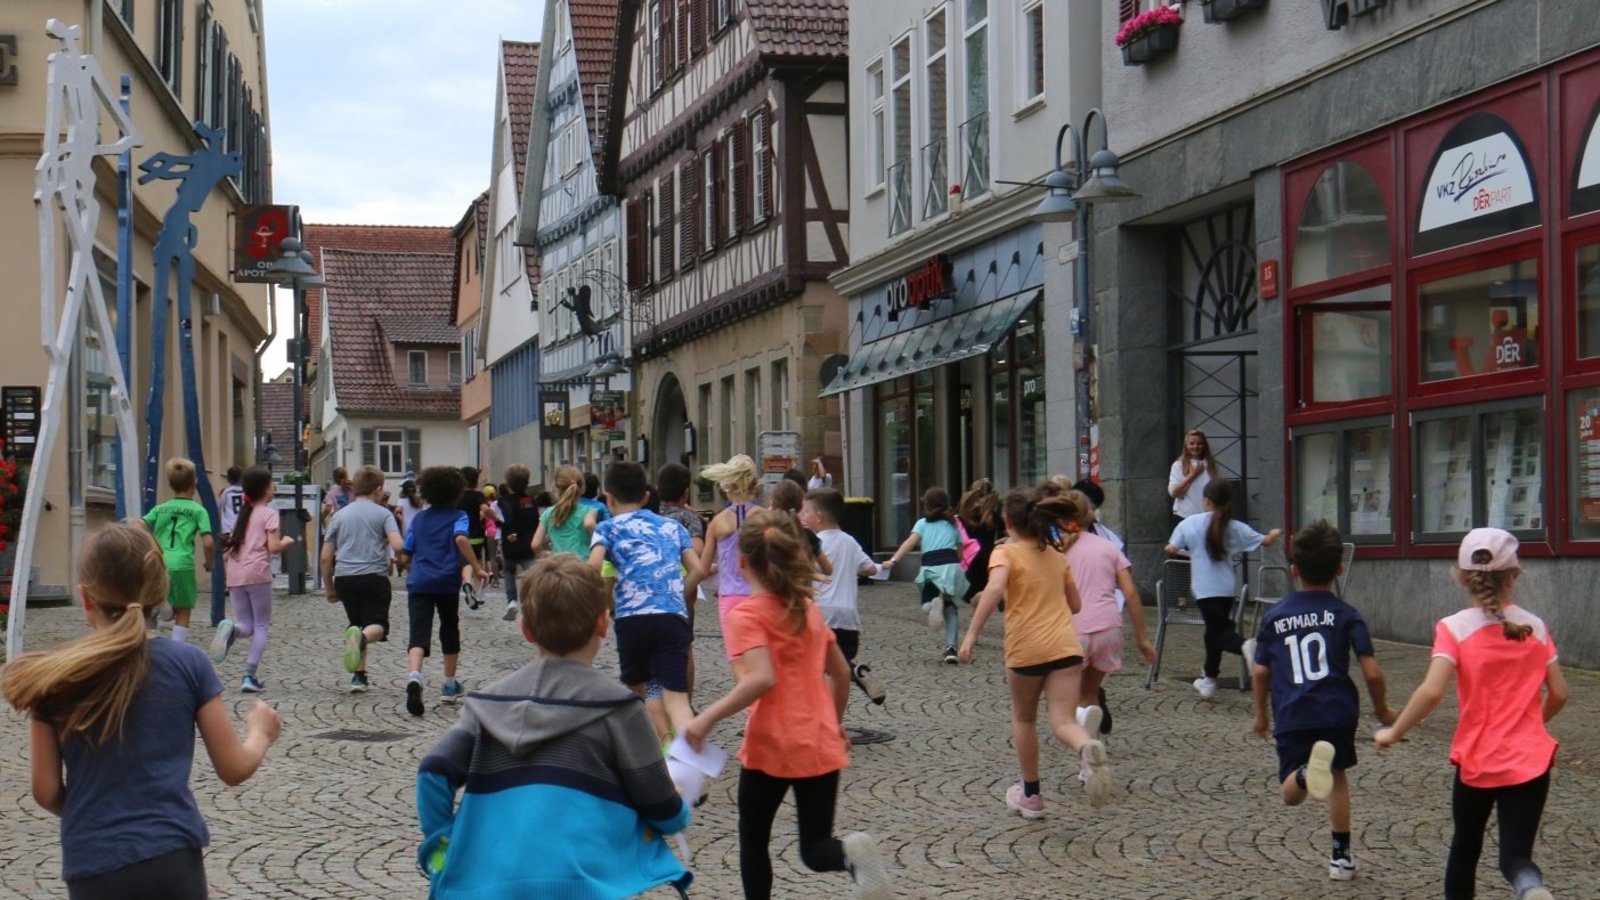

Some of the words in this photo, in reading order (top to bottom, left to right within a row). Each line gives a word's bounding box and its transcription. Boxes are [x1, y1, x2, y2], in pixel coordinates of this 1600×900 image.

[1436, 181, 1456, 199] VKZ
[1496, 337, 1521, 364] DER
[1579, 414, 1591, 430] 20
[1274, 612, 1319, 634] NEYMAR
[1320, 609, 1335, 627] JR
[1284, 631, 1330, 685] 10
